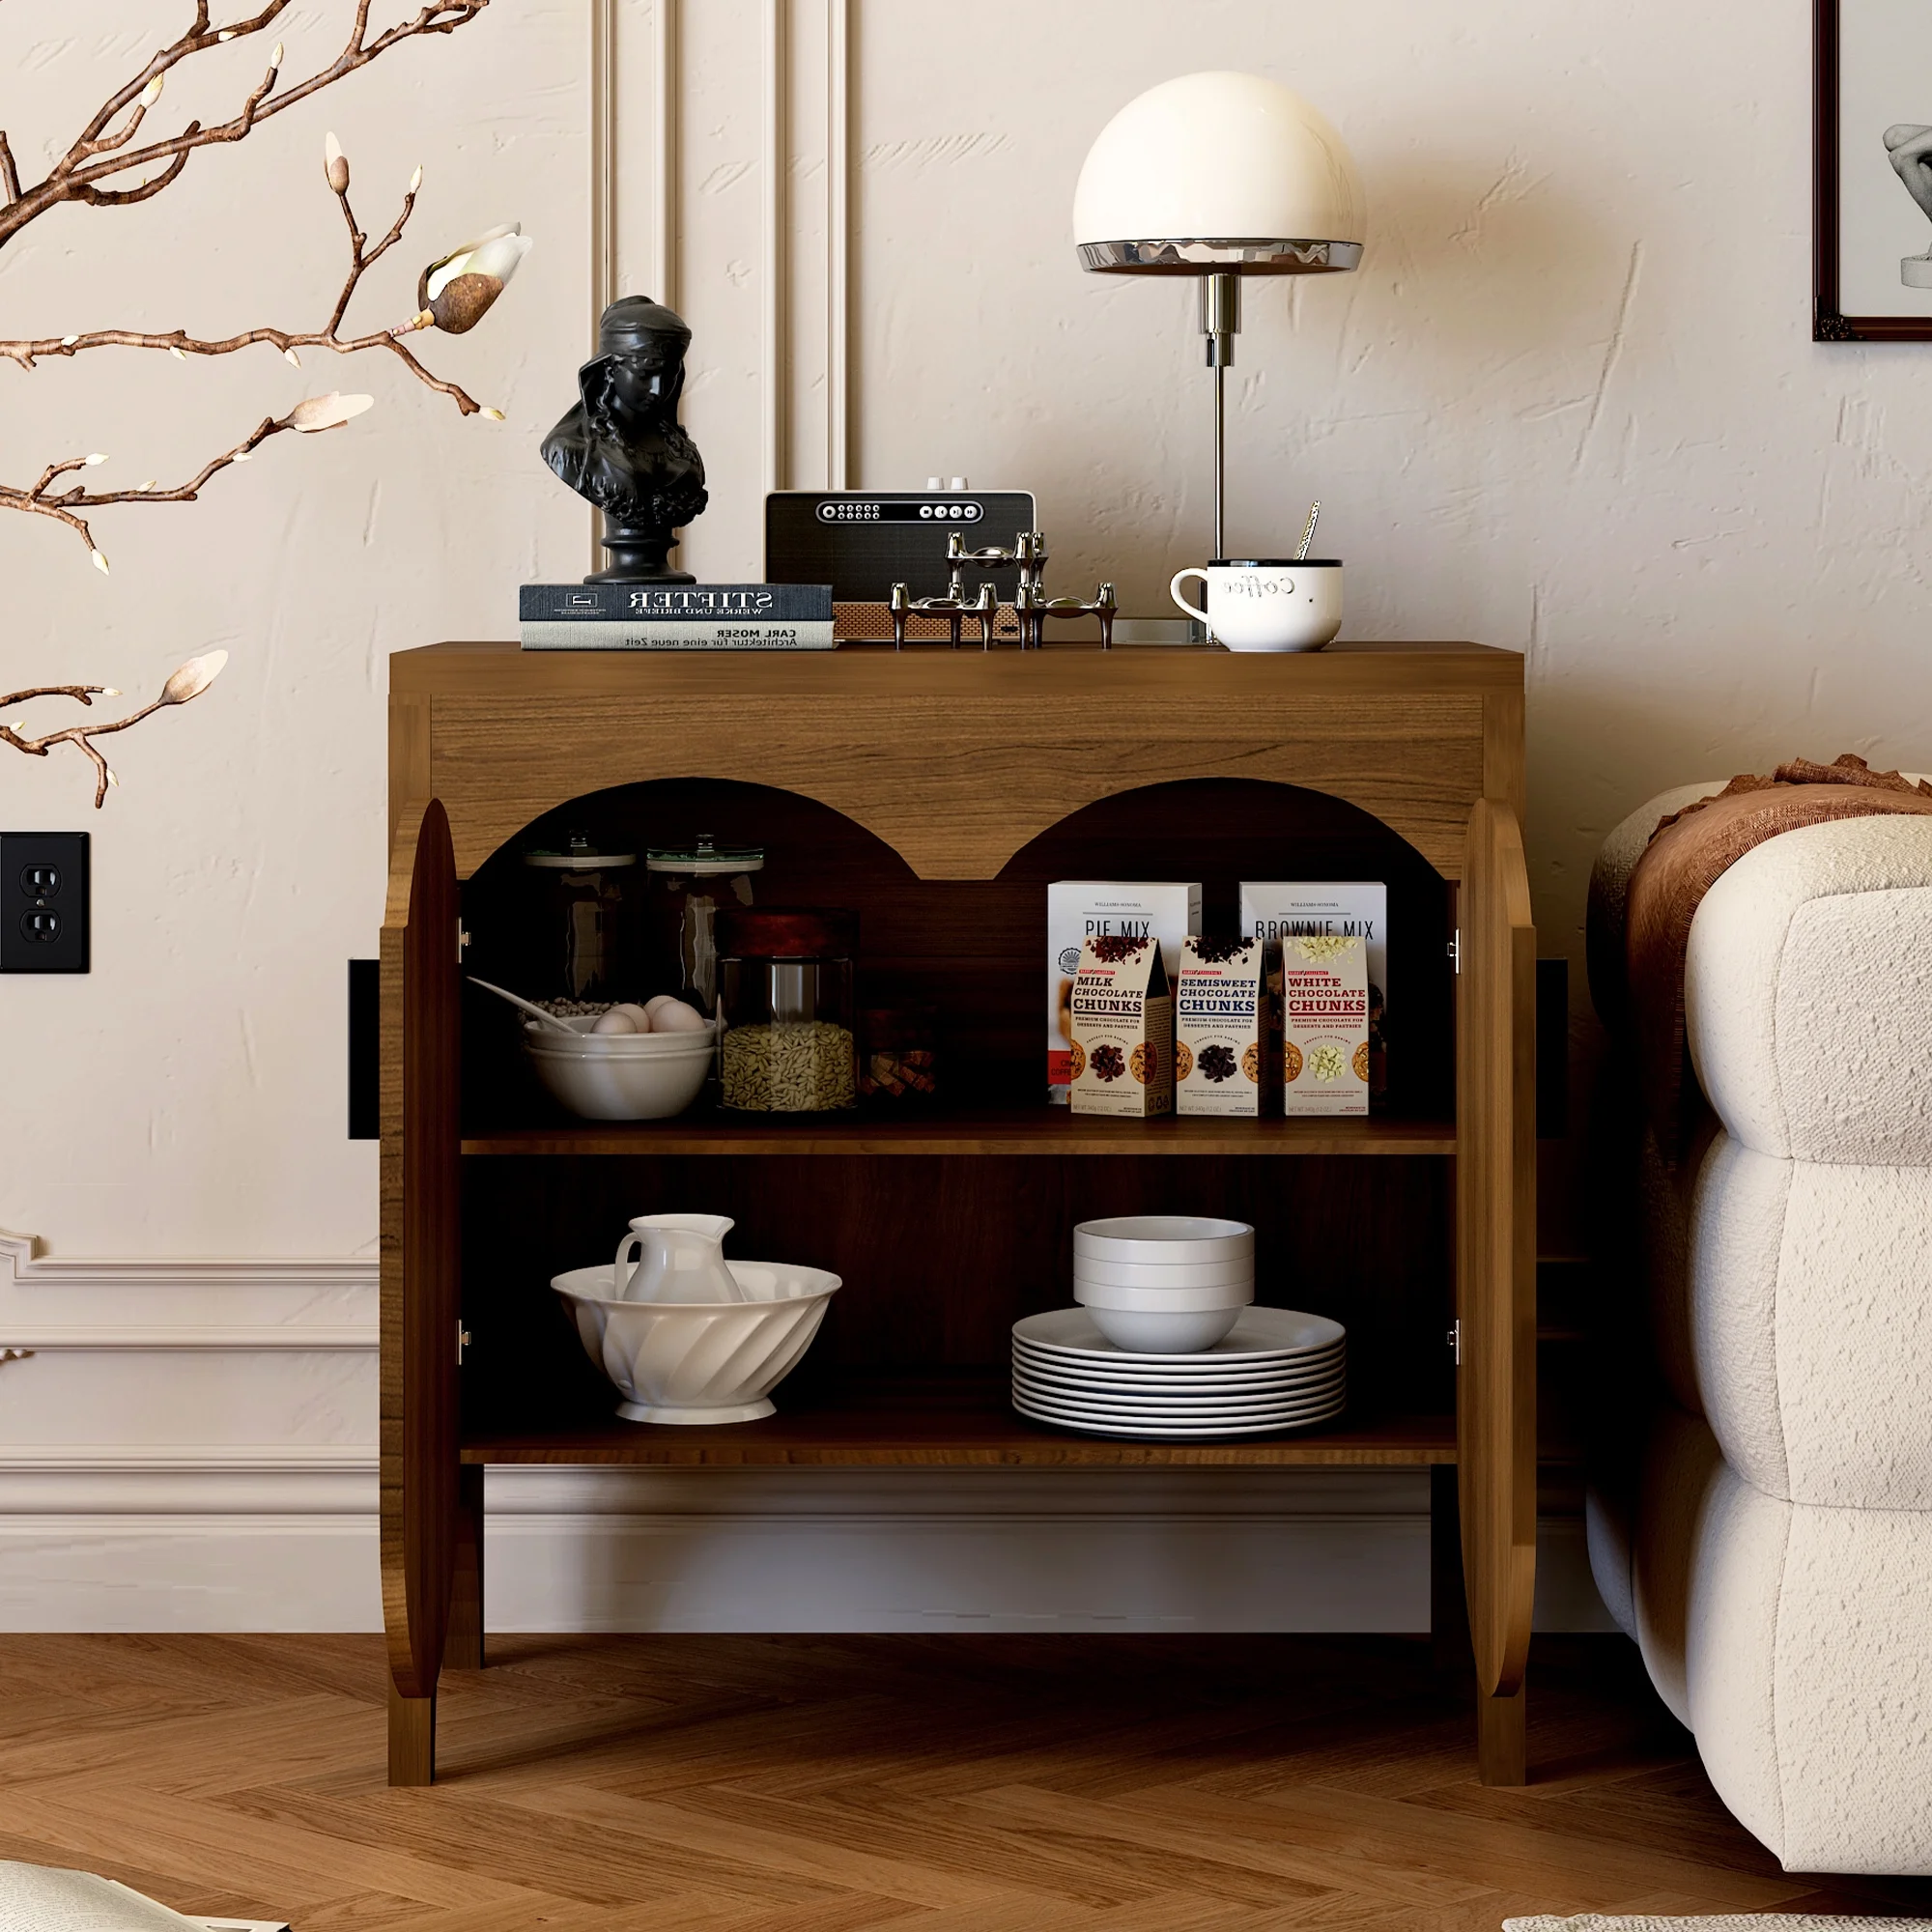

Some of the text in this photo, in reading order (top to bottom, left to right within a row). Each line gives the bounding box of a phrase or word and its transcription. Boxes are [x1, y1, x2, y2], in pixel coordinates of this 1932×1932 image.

[1122, 921, 1150, 938] MIX
[1256, 921, 1374, 940] BROWNIE MIX
[1077, 977, 1114, 986] MILK
[1289, 978, 1342, 987] WHITE
[1074, 988, 1144, 998] CHOCOLATE
[1180, 989, 1255, 998] CHOCOLATE
[1073, 999, 1142, 1012] CHUNKS
[1179, 1000, 1255, 1011] CHUNKS
[1290, 1000, 1366, 1011] CHUNKS
